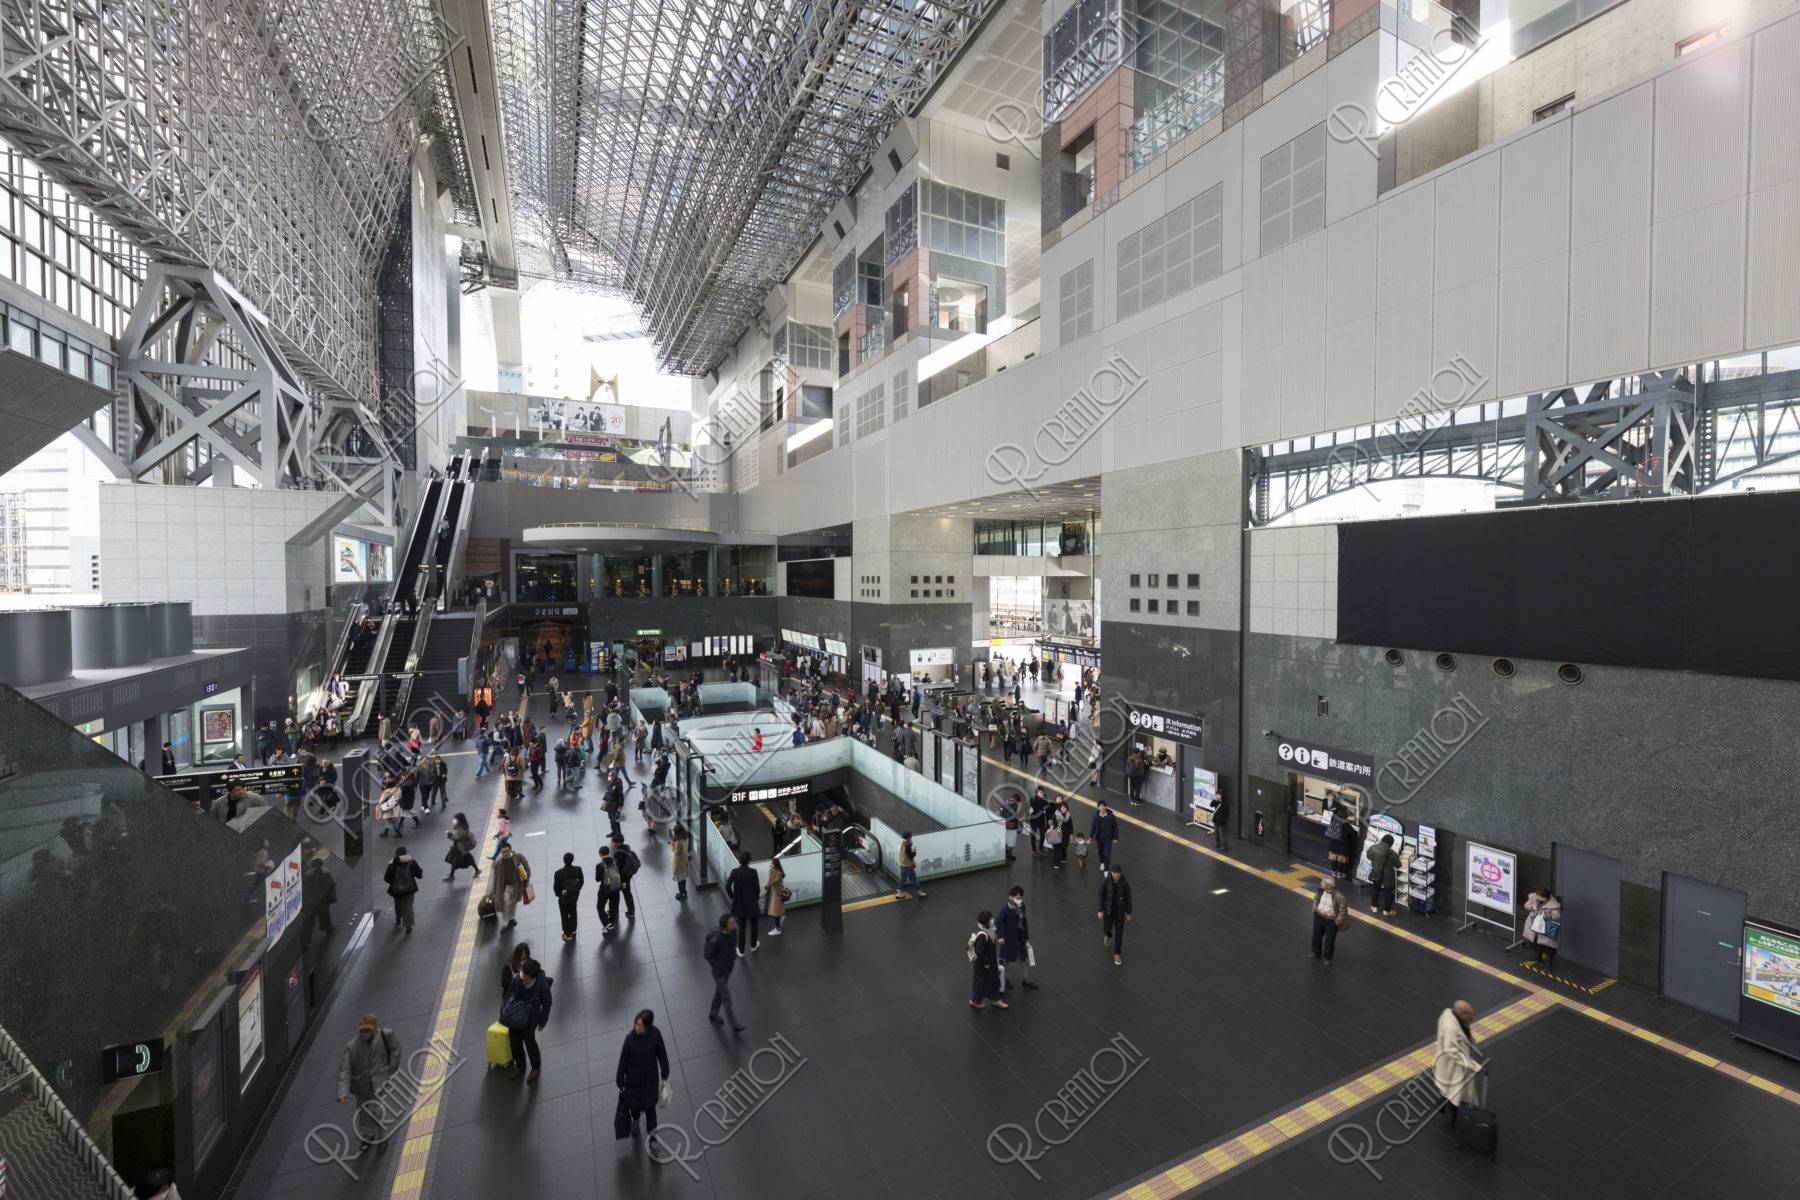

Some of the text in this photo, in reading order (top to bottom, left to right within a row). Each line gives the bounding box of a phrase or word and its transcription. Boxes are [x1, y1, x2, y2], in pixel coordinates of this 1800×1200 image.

[1172, 719, 1201, 732] Information
[1329, 758, 1371, 777] 鉄道案内所
[732, 792, 746, 802] B1F
